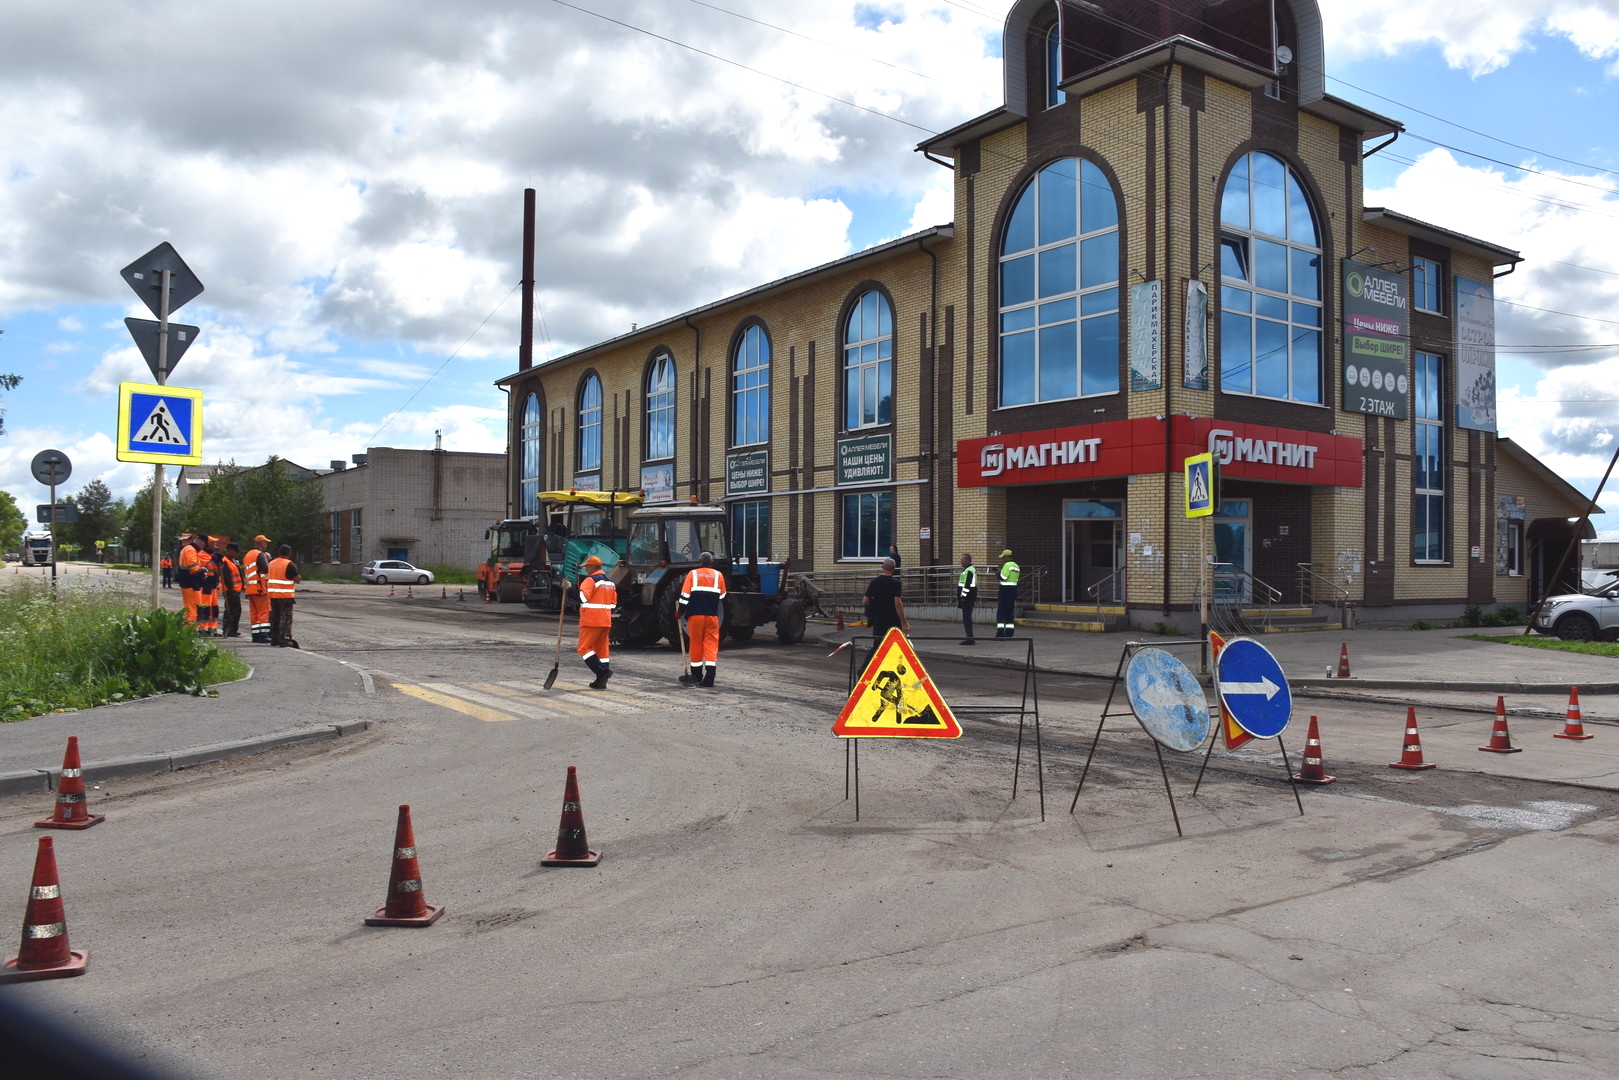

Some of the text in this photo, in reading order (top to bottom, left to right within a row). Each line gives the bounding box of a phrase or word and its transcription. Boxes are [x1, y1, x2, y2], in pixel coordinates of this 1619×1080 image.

[1364, 275, 1398, 294] АЛЛЕЯ
[1364, 287, 1406, 310] МЕБЕЛИ
[1353, 318, 1399, 335] Цены НИЖЕ!
[1354, 338, 1403, 356] Выбор ШИРЕ!
[1360, 397, 1395, 415] 2 ЭТАЖ
[866, 442, 888, 451] МЕБЕЛИ
[1006, 437, 1102, 469] МАГНИТ
[1234, 437, 1318, 468] МАГНИТ
[843, 453, 885, 467] НАШИ ЦЕНЫ
[731, 468, 763, 480] ЦЕНЫ НИЖЕ!
[844, 465, 884, 479] УДИВЛЯЮТ!
[730, 478, 765, 490] ВЫБОР ШИРЕ!
